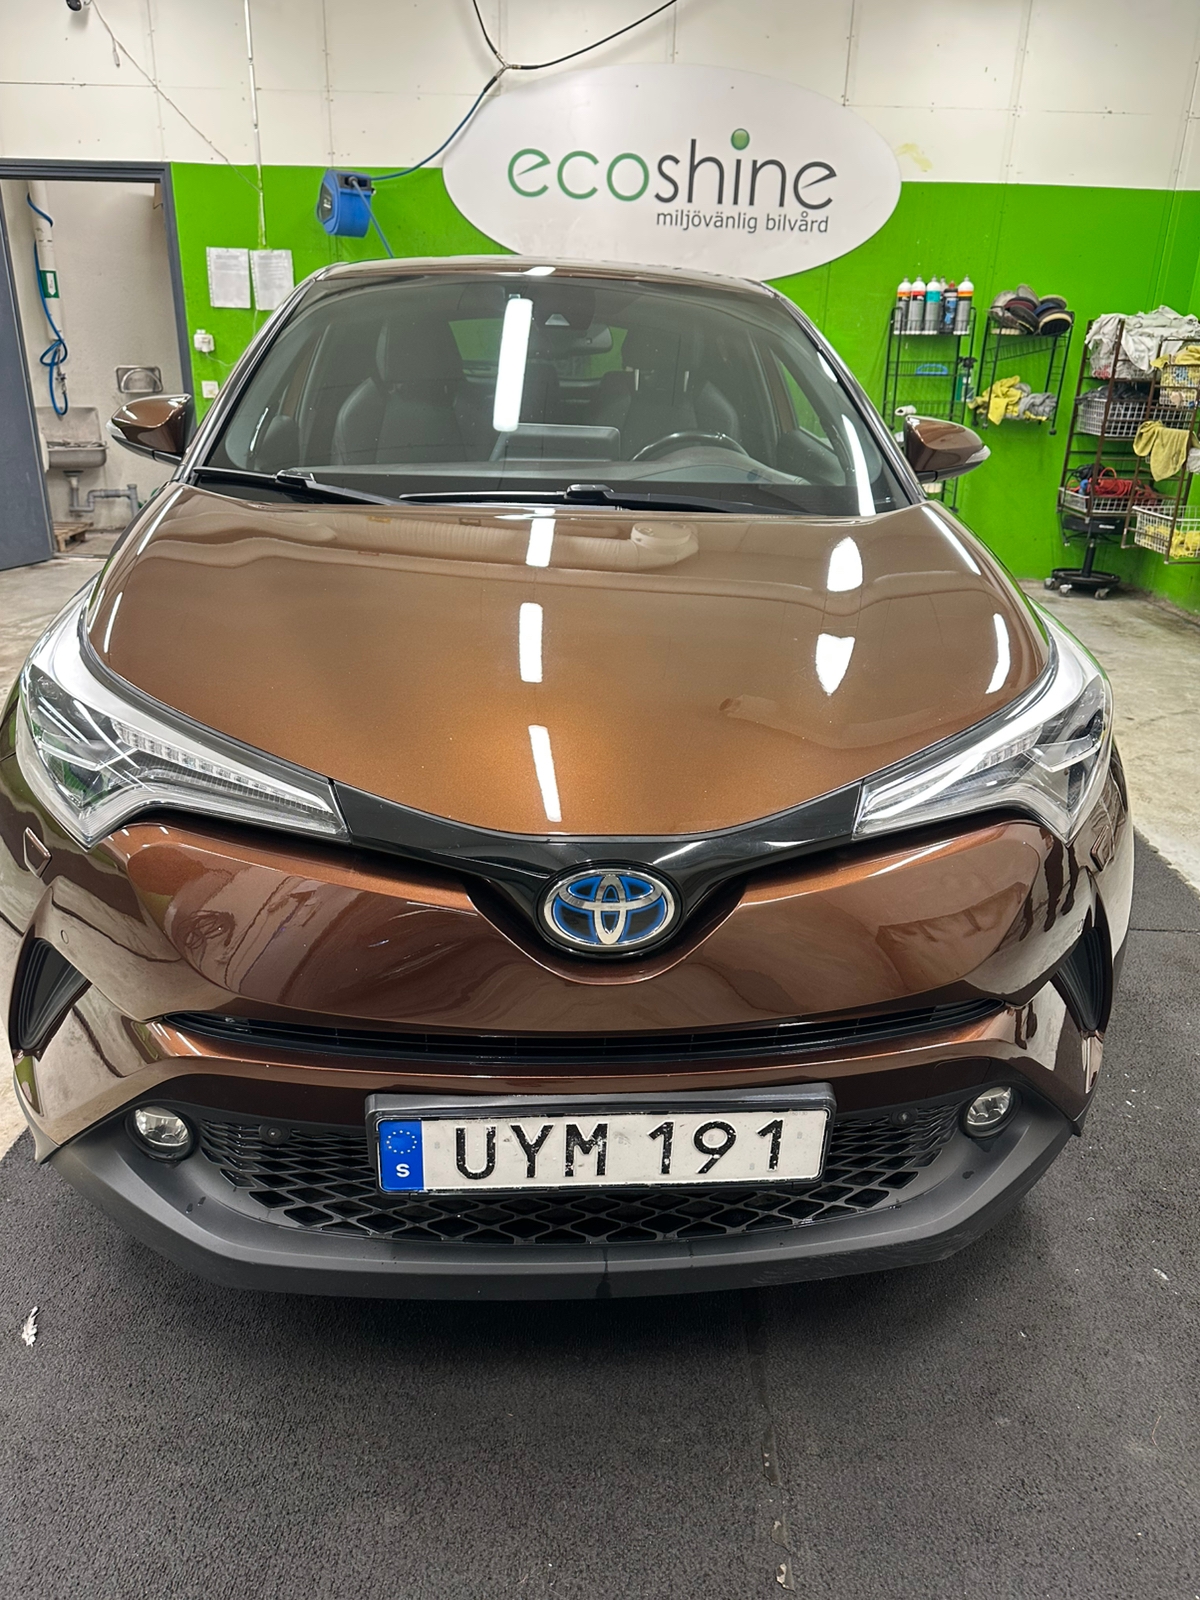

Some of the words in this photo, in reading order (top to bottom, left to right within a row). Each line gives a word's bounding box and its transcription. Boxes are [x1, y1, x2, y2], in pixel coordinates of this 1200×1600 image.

[508, 128, 837, 210] ecoshine
[656, 210, 758, 234] miljövänlig
[765, 211, 829, 234] bilvård
[396, 1163, 411, 1178] S
[455, 1123, 609, 1180] UYM
[649, 1119, 784, 1175] 191
